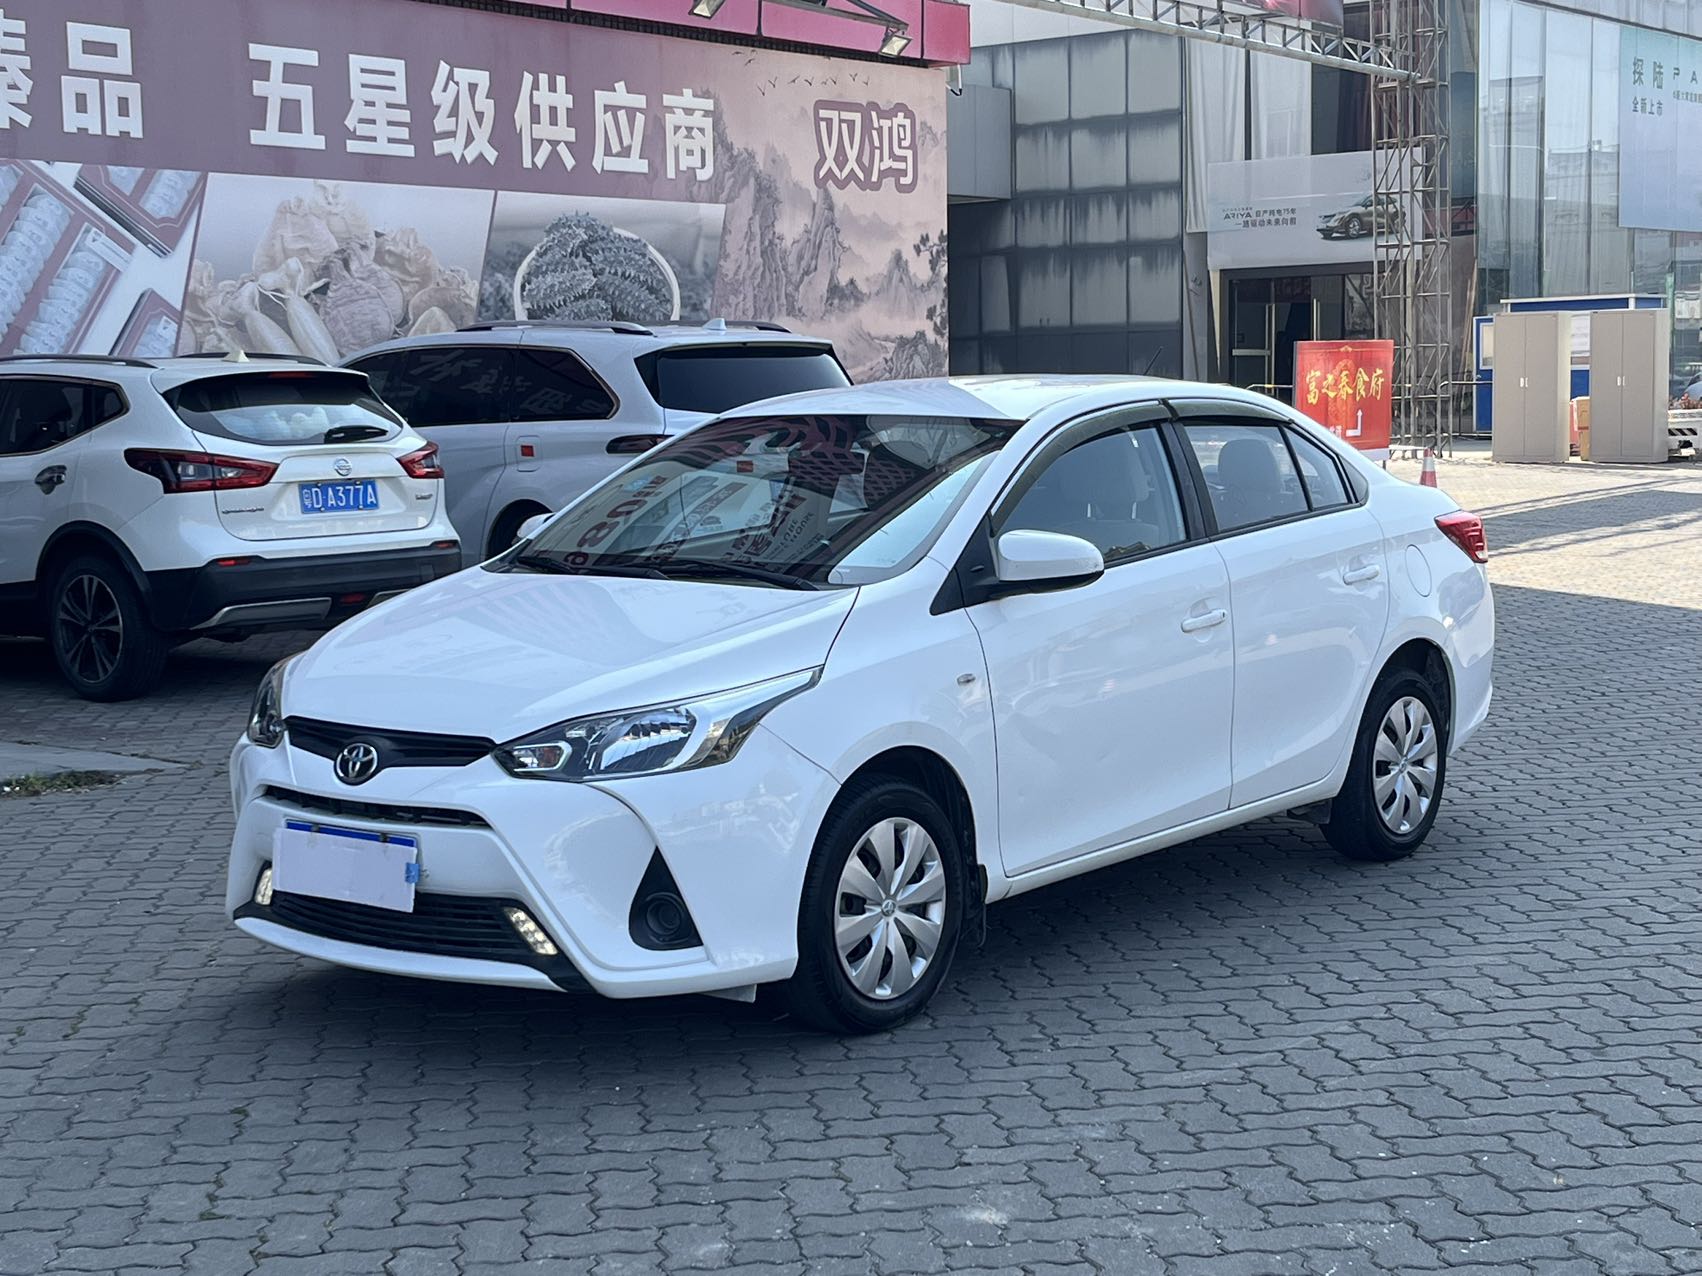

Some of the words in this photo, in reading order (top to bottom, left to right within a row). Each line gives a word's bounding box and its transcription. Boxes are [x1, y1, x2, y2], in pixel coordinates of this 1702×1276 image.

[1632, 56, 1664, 90] 探陆
[248, 43, 715, 181] 五星级供应商
[1632, 96, 1663, 116] 全新上市
[817, 108, 917, 186] 双鸿
[1223, 211, 1252, 220] ARIYA
